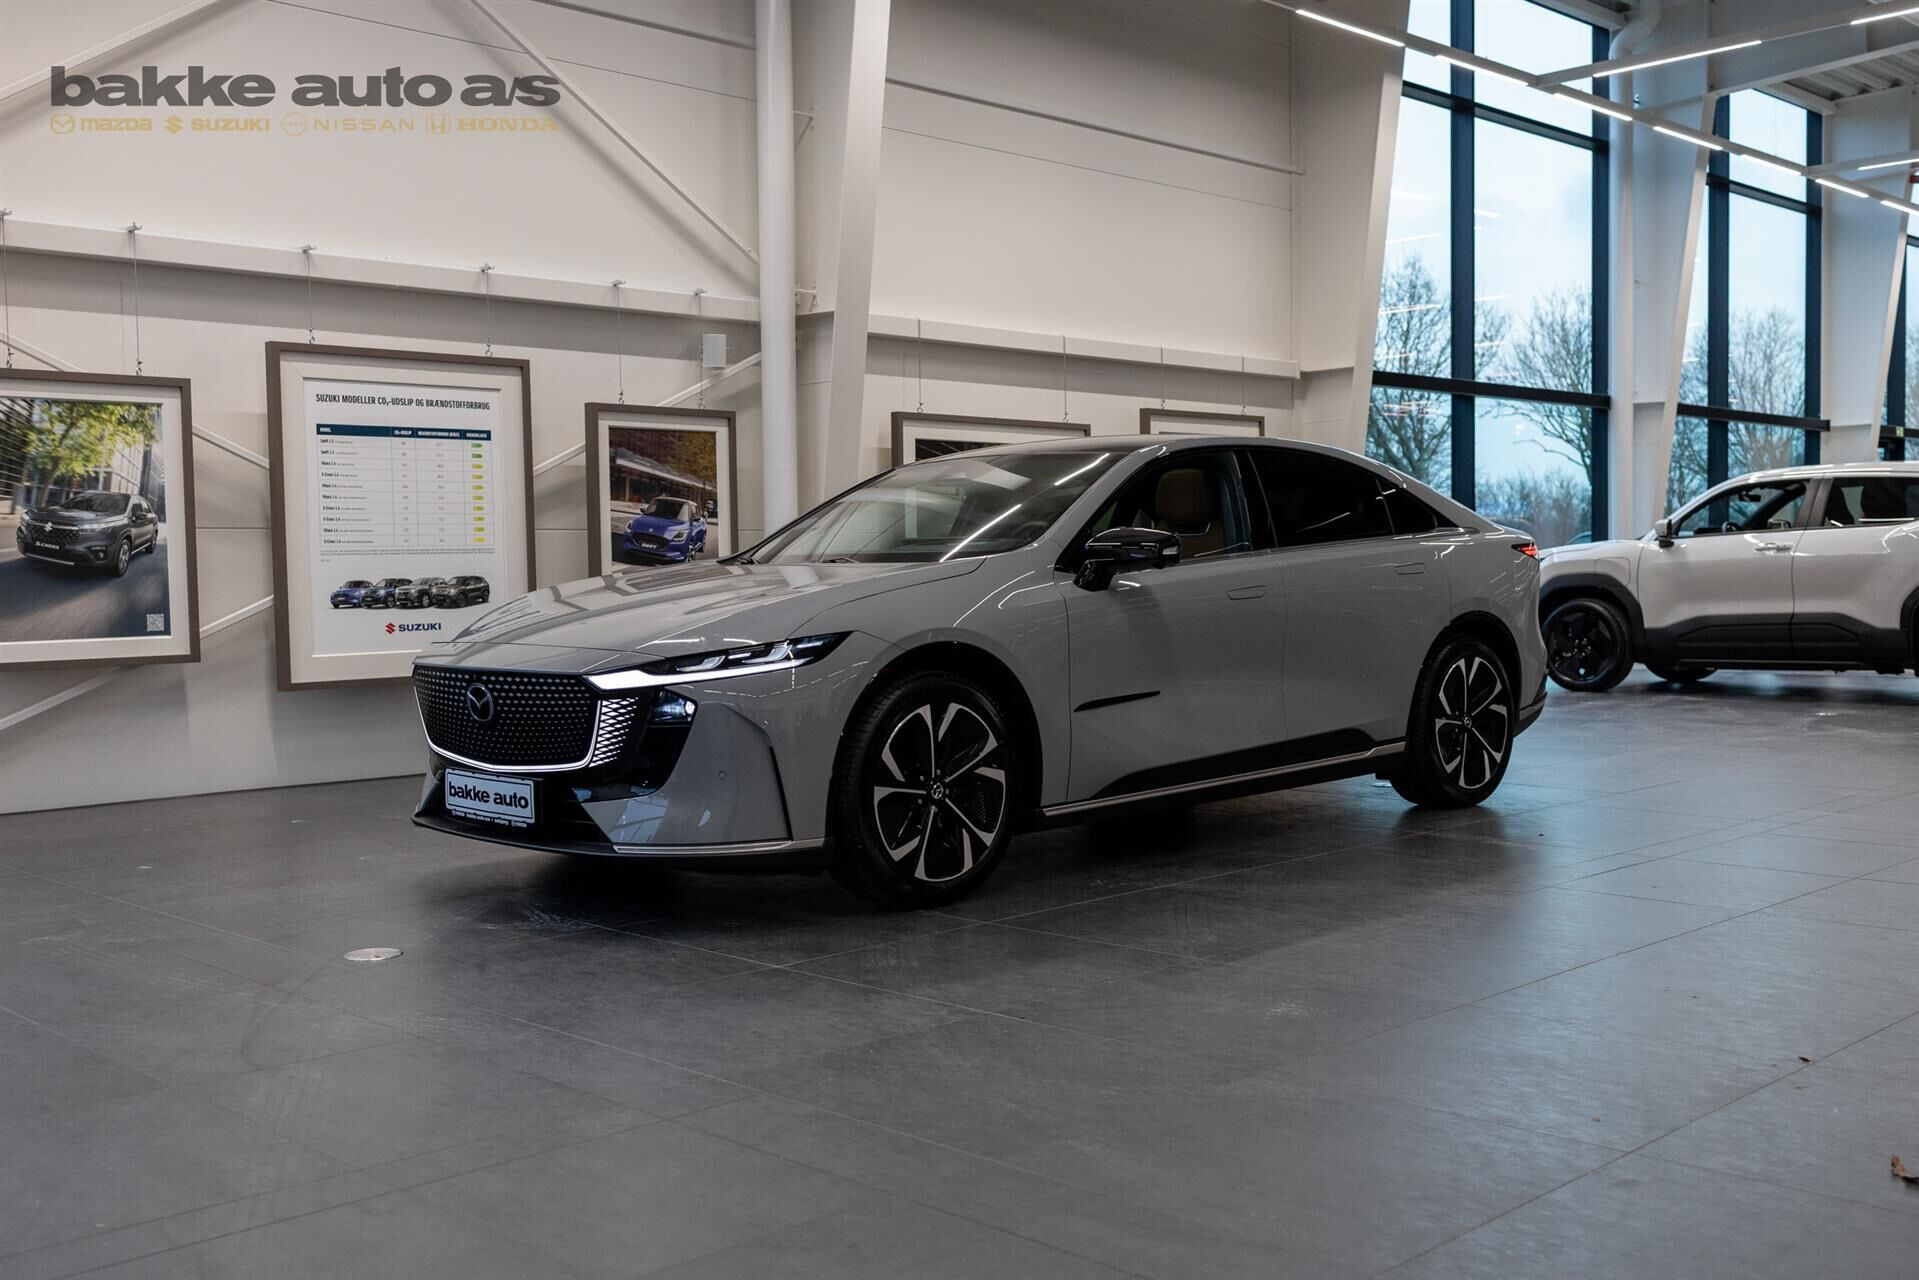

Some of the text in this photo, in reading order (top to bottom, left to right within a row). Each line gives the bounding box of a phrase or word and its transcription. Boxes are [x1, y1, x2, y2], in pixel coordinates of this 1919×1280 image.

[316, 393, 340, 403] SUZUKI
[341, 395, 376, 405] MODELLER
[415, 399, 424, 407] OG
[398, 622, 441, 632] SUZUKI
[449, 781, 529, 809] bakke auto
